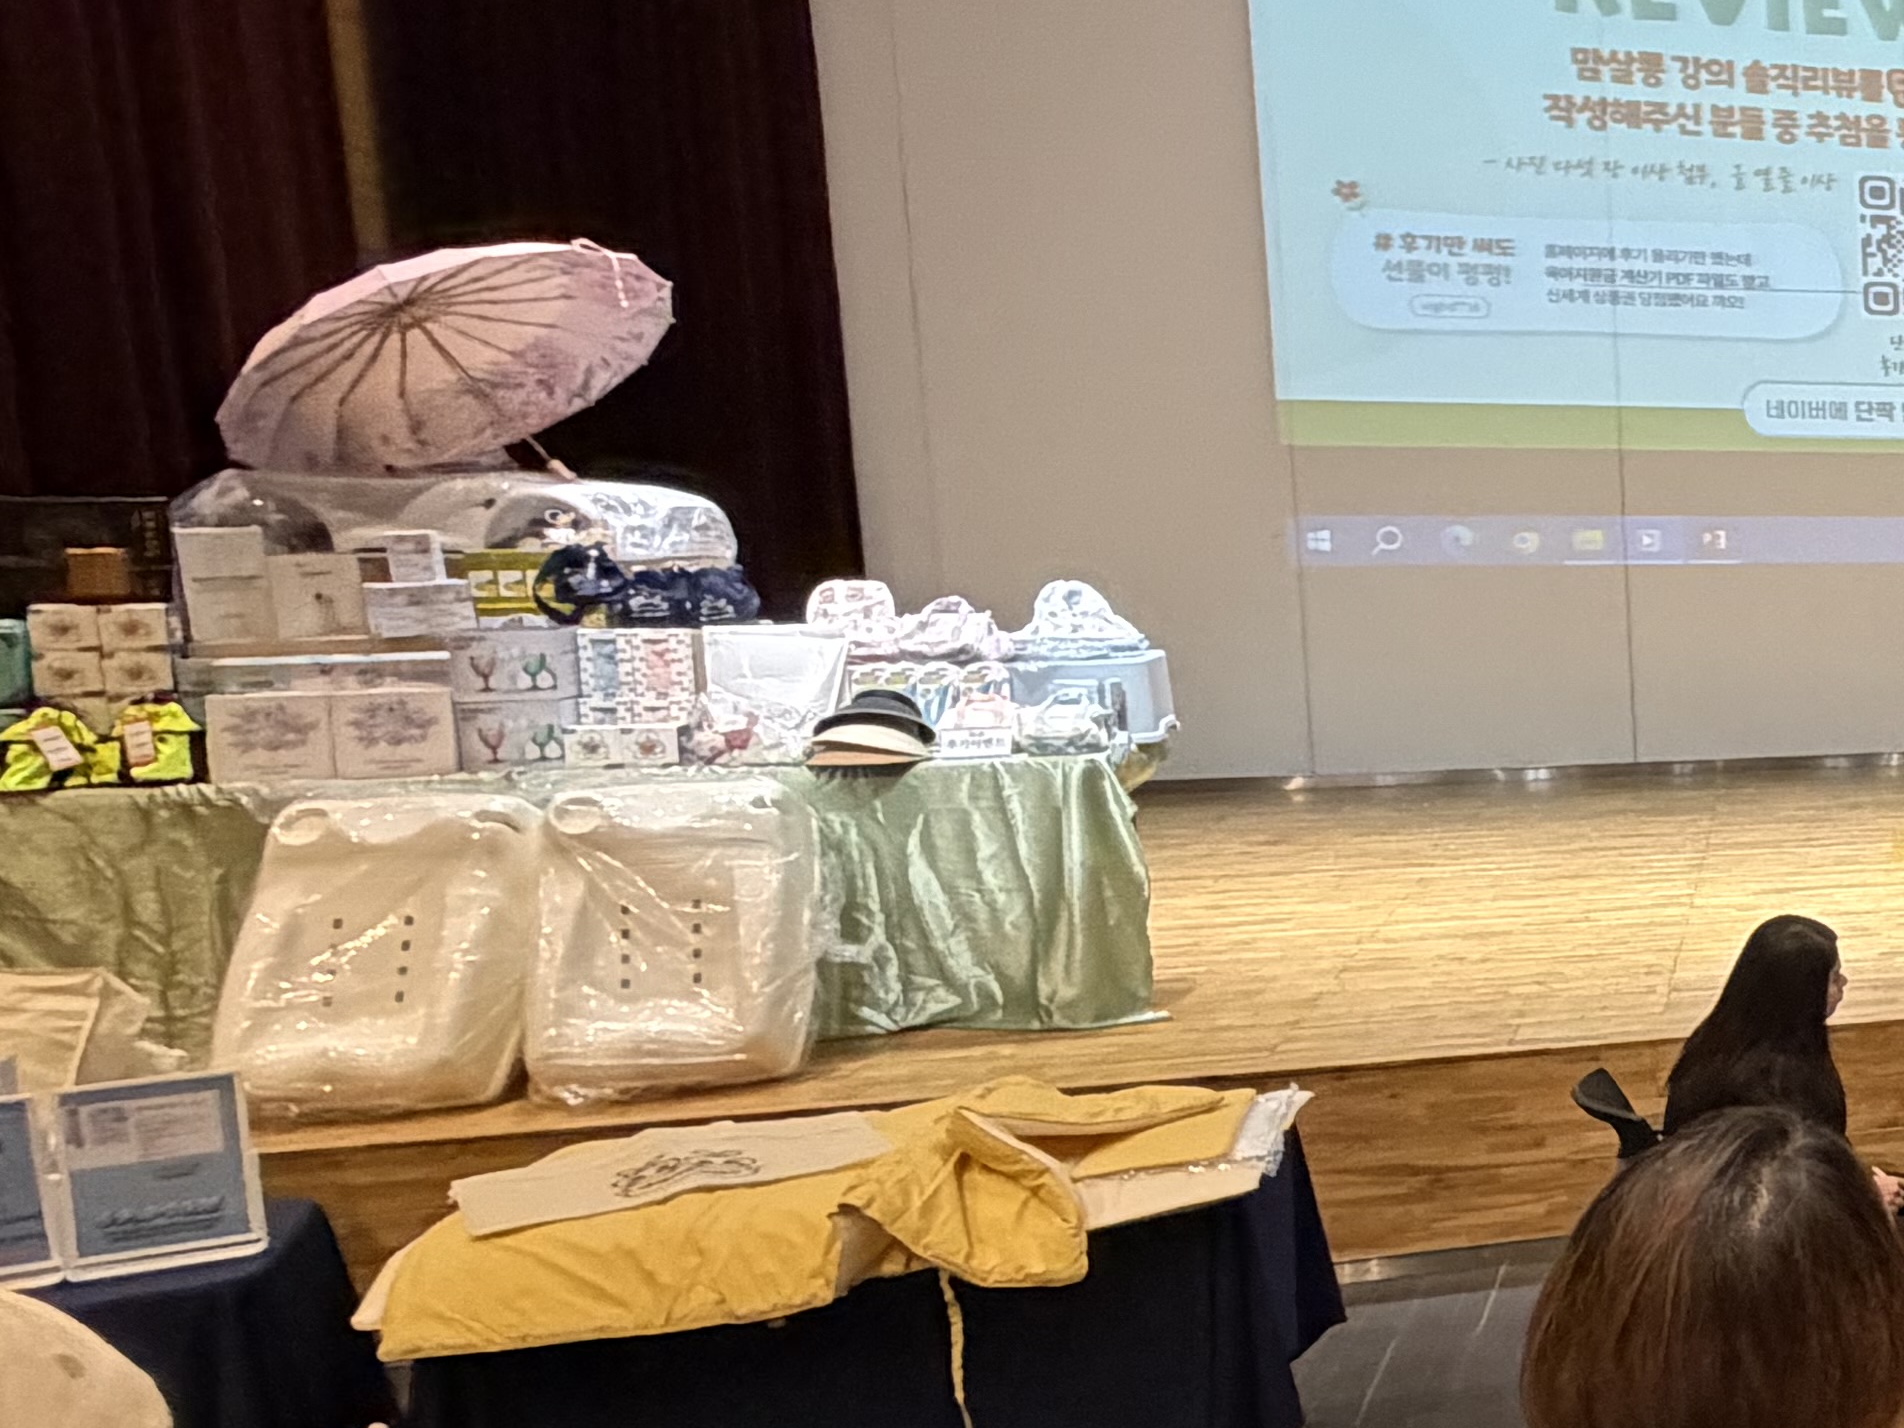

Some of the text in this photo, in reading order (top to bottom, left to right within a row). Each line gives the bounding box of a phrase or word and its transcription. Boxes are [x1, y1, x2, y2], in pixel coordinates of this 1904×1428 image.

[1570, 47, 1667, 88] 맘살롱
[1670, 55, 1736, 91] 강의
[1742, 59, 1884, 103] 솔직리뷰를
[1542, 93, 1702, 137] 작성해주신
[1709, 104, 1765, 141] 분들
[1772, 108, 1798, 145] 중
[1805, 111, 1890, 150] 추첨을
[1399, 232, 1467, 257] 후기만
[1382, 259, 1450, 283] 선물이
[1665, 272, 1693, 285] PDF
[1546, 289, 1591, 304] 신세계
[1766, 399, 1848, 421] 네이버에
[1854, 400, 1897, 422] 단짝
